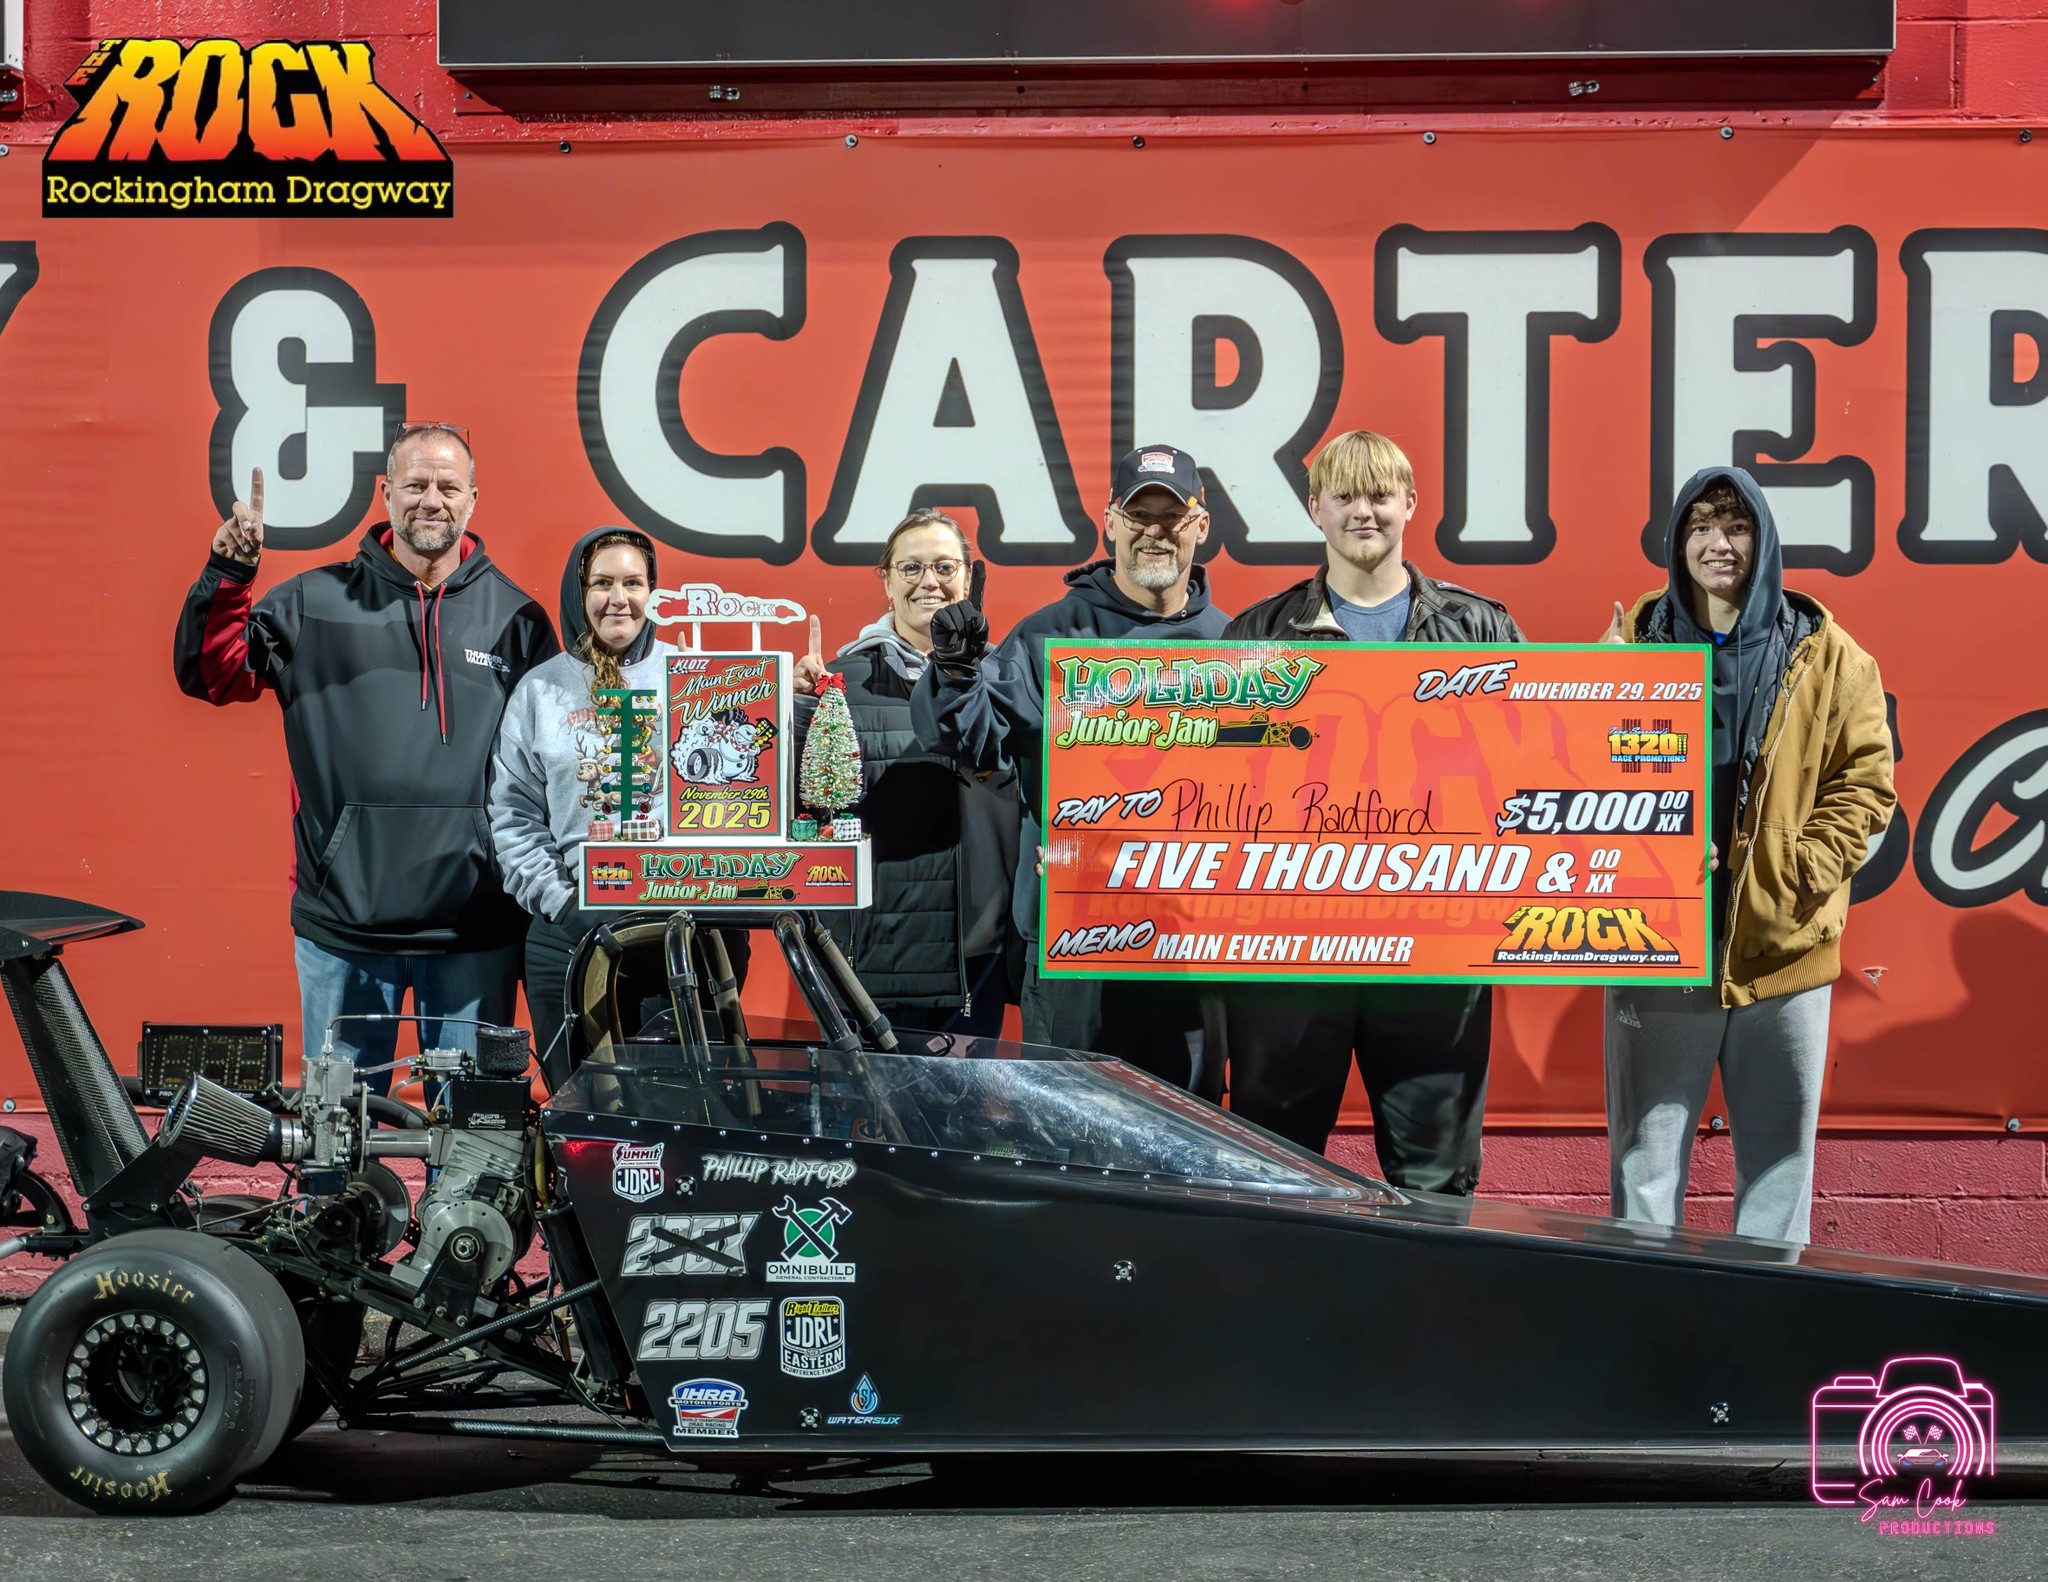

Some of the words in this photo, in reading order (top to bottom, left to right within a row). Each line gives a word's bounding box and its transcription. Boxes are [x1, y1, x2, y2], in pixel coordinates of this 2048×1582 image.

[209, 266, 406, 550] &
[576, 220, 2048, 577] CARTER
[464, 648, 503, 664] THUNDER
[466, 655, 494, 669] VALLEY
[675, 659, 710, 670] KLOTZ
[671, 674, 722, 700] Main
[723, 656, 776, 687] Event
[1056, 656, 1327, 711] HOLIDAY
[1413, 660, 1518, 702] DATE
[1508, 682, 1613, 700] NOVEMBER
[1619, 682, 1645, 702] 29,
[1650, 682, 1703, 700] 2025
[671, 680, 777, 726] Winner
[1055, 709, 1159, 749] Junior
[1154, 711, 1219, 750] Jam
[1608, 733, 1678, 755] 1320
[680, 786, 741, 800] November
[742, 786, 769, 800] 29th
[678, 802, 771, 829] 2025
[1052, 792, 1119, 828] PAY
[1119, 788, 1164, 819] TO
[1162, 778, 1273, 843] Phillip
[1292, 781, 1438, 843] Radford
[1495, 791, 1658, 837] $5,000
[1655, 813, 1686, 832] XX
[592, 869, 629, 881] 1320
[636, 851, 804, 881] HOLIDAY
[807, 866, 851, 882] ROCK
[1105, 840, 1229, 890] FIVE
[1236, 842, 1532, 892] THOUSAND
[1535, 852, 1578, 893] &
[638, 880, 703, 902] Junior
[699, 881, 738, 902] Jam
[1585, 873, 1618, 893] XX
[1048, 919, 1157, 960] MEMO
[1152, 933, 1222, 960] MAIN
[1225, 935, 1307, 961] EVENT
[1308, 936, 1416, 962] WINNER
[1496, 905, 1678, 951] ROCK
[1497, 951, 1680, 963] RockinghamDragway.com
[617, 1168, 660, 1195] JDRL
[702, 1153, 769, 1184] PHILLIP
[770, 1156, 858, 1189] RADFORD
[768, 1264, 854, 1276] OMNIBUILD
[94, 1266, 195, 1303] Hoosier
[636, 1298, 772, 1361] 2205
[786, 1316, 839, 1348] JDRL
[784, 1347, 842, 1369] EASTERN
[785, 1365, 821, 1376] CONFERENCE
[821, 1363, 842, 1375] FINALS
[674, 1399, 742, 1407] MOTORSPORTS
[680, 1388, 737, 1401] IHRA
[675, 1428, 736, 1436] MEMBER
[827, 1416, 901, 1425] WATERSUX
